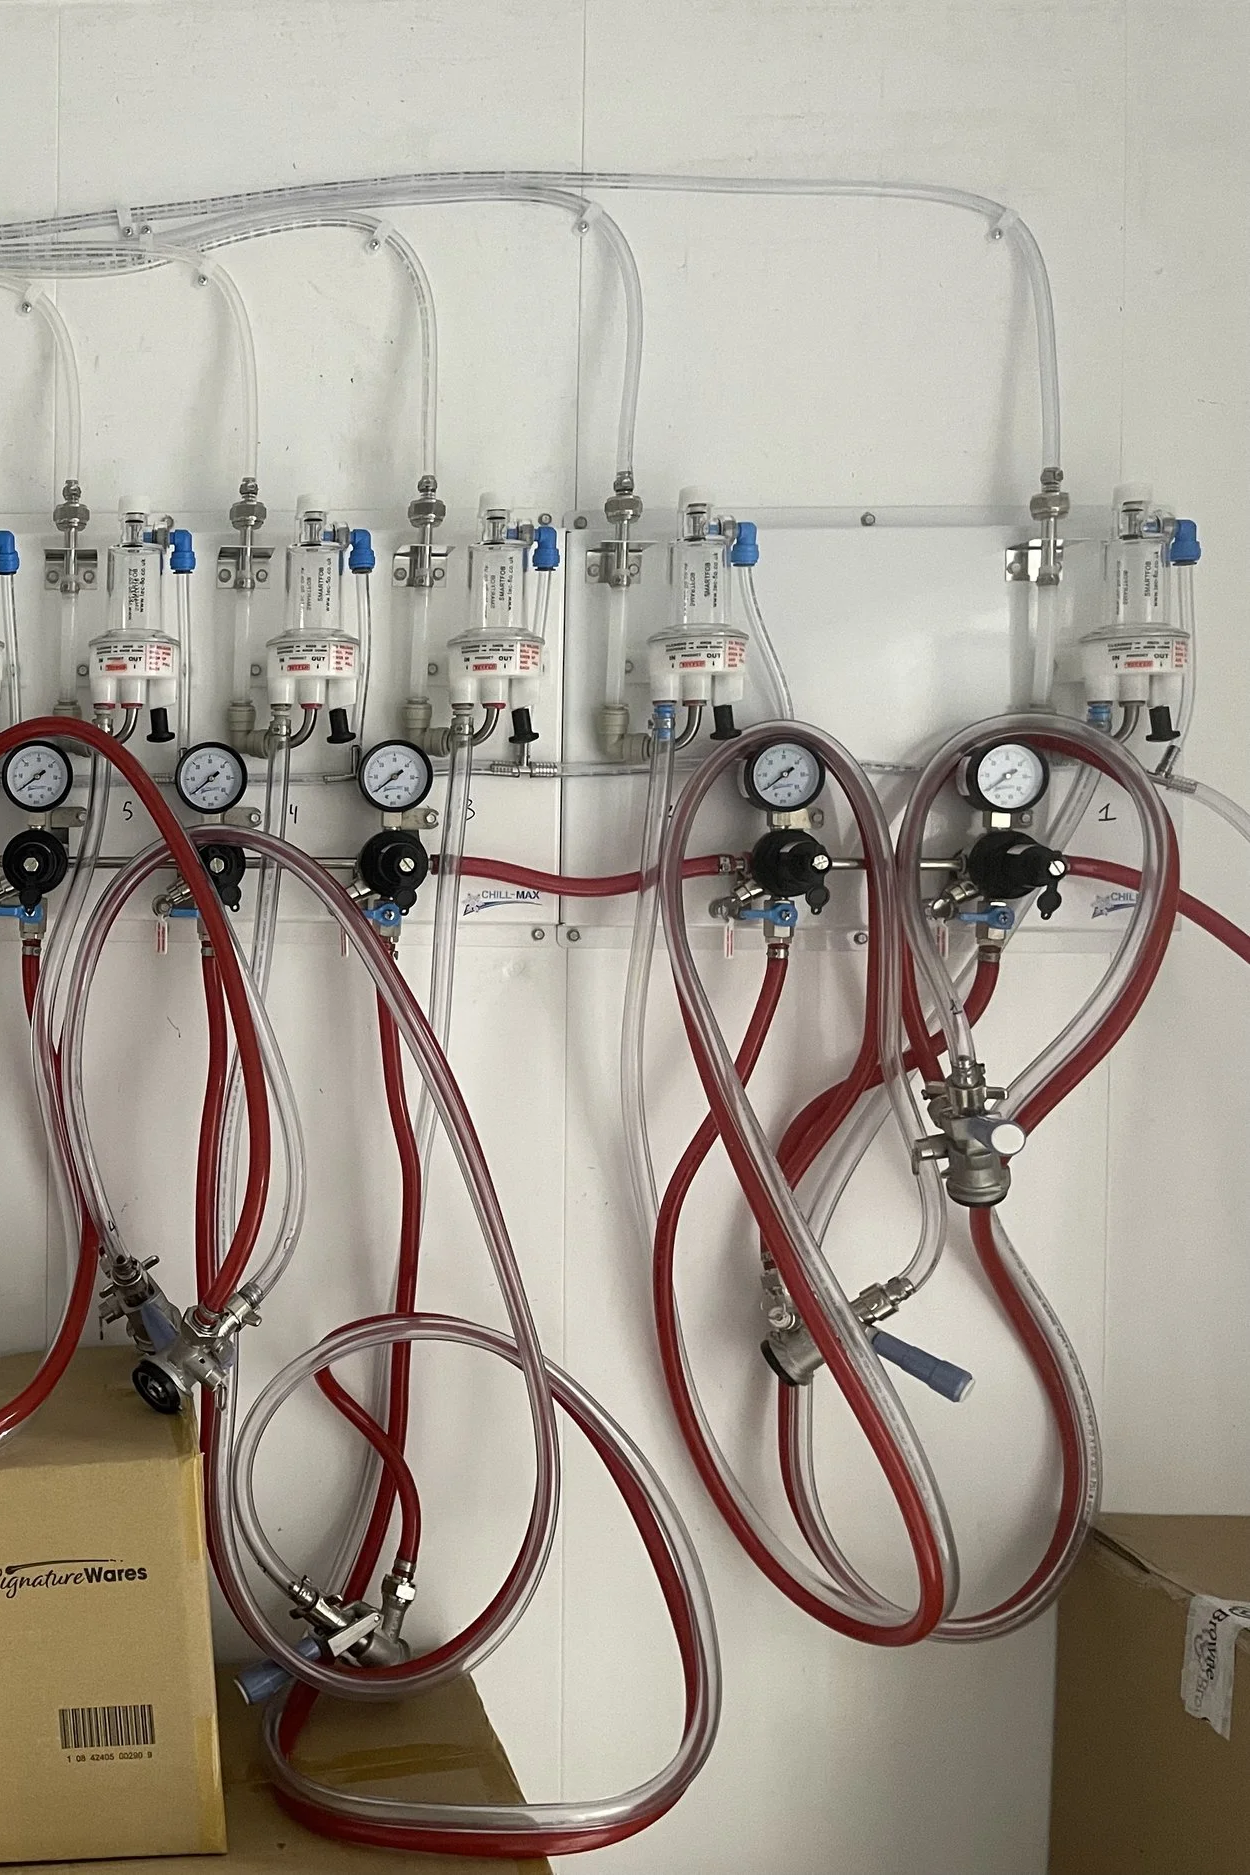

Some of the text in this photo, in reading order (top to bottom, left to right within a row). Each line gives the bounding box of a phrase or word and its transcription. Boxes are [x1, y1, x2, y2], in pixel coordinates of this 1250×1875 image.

[122, 801, 133, 821] 5
[289, 803, 298, 824] 4
[1098, 803, 1117, 821] 1
[481, 890, 540, 899] CHILL-MAX
[67, 1755, 72, 1763] 1
